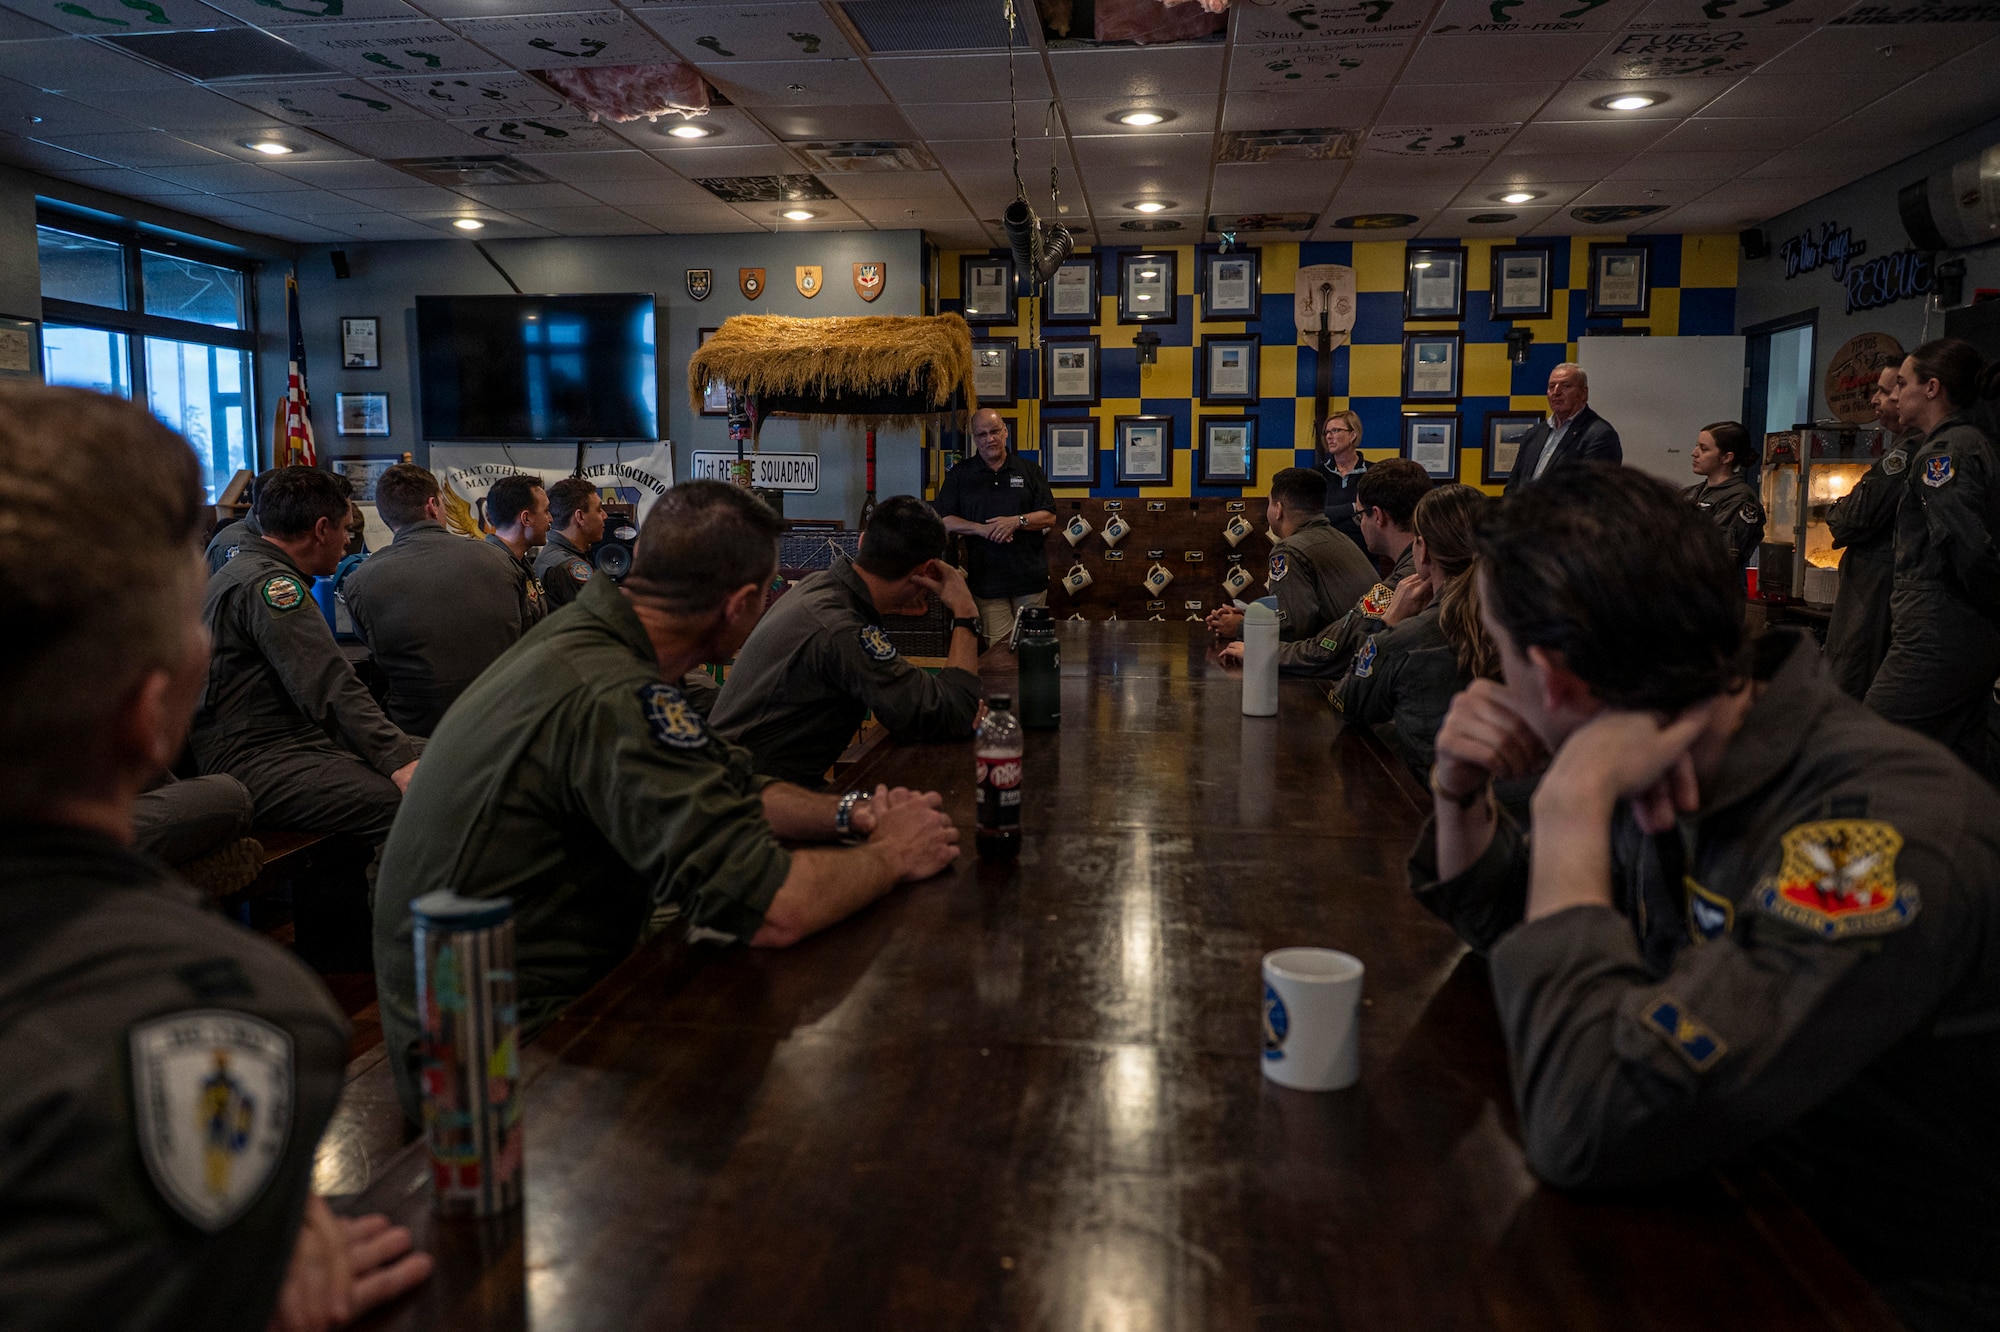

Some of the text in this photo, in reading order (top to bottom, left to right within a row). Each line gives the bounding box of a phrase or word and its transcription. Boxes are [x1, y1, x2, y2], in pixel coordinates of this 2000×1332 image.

[1620, 31, 1744, 45] FUEGO
[1612, 43, 1749, 54] KRYDER
[1845, 252, 1933, 315] RESCUE
[450, 465, 483, 483] THAT
[574, 463, 666, 495] SCUE ASSOCIATIO
[697, 459, 814, 483] 71st REE SQUADRON
[465, 477, 490, 490] MAY
